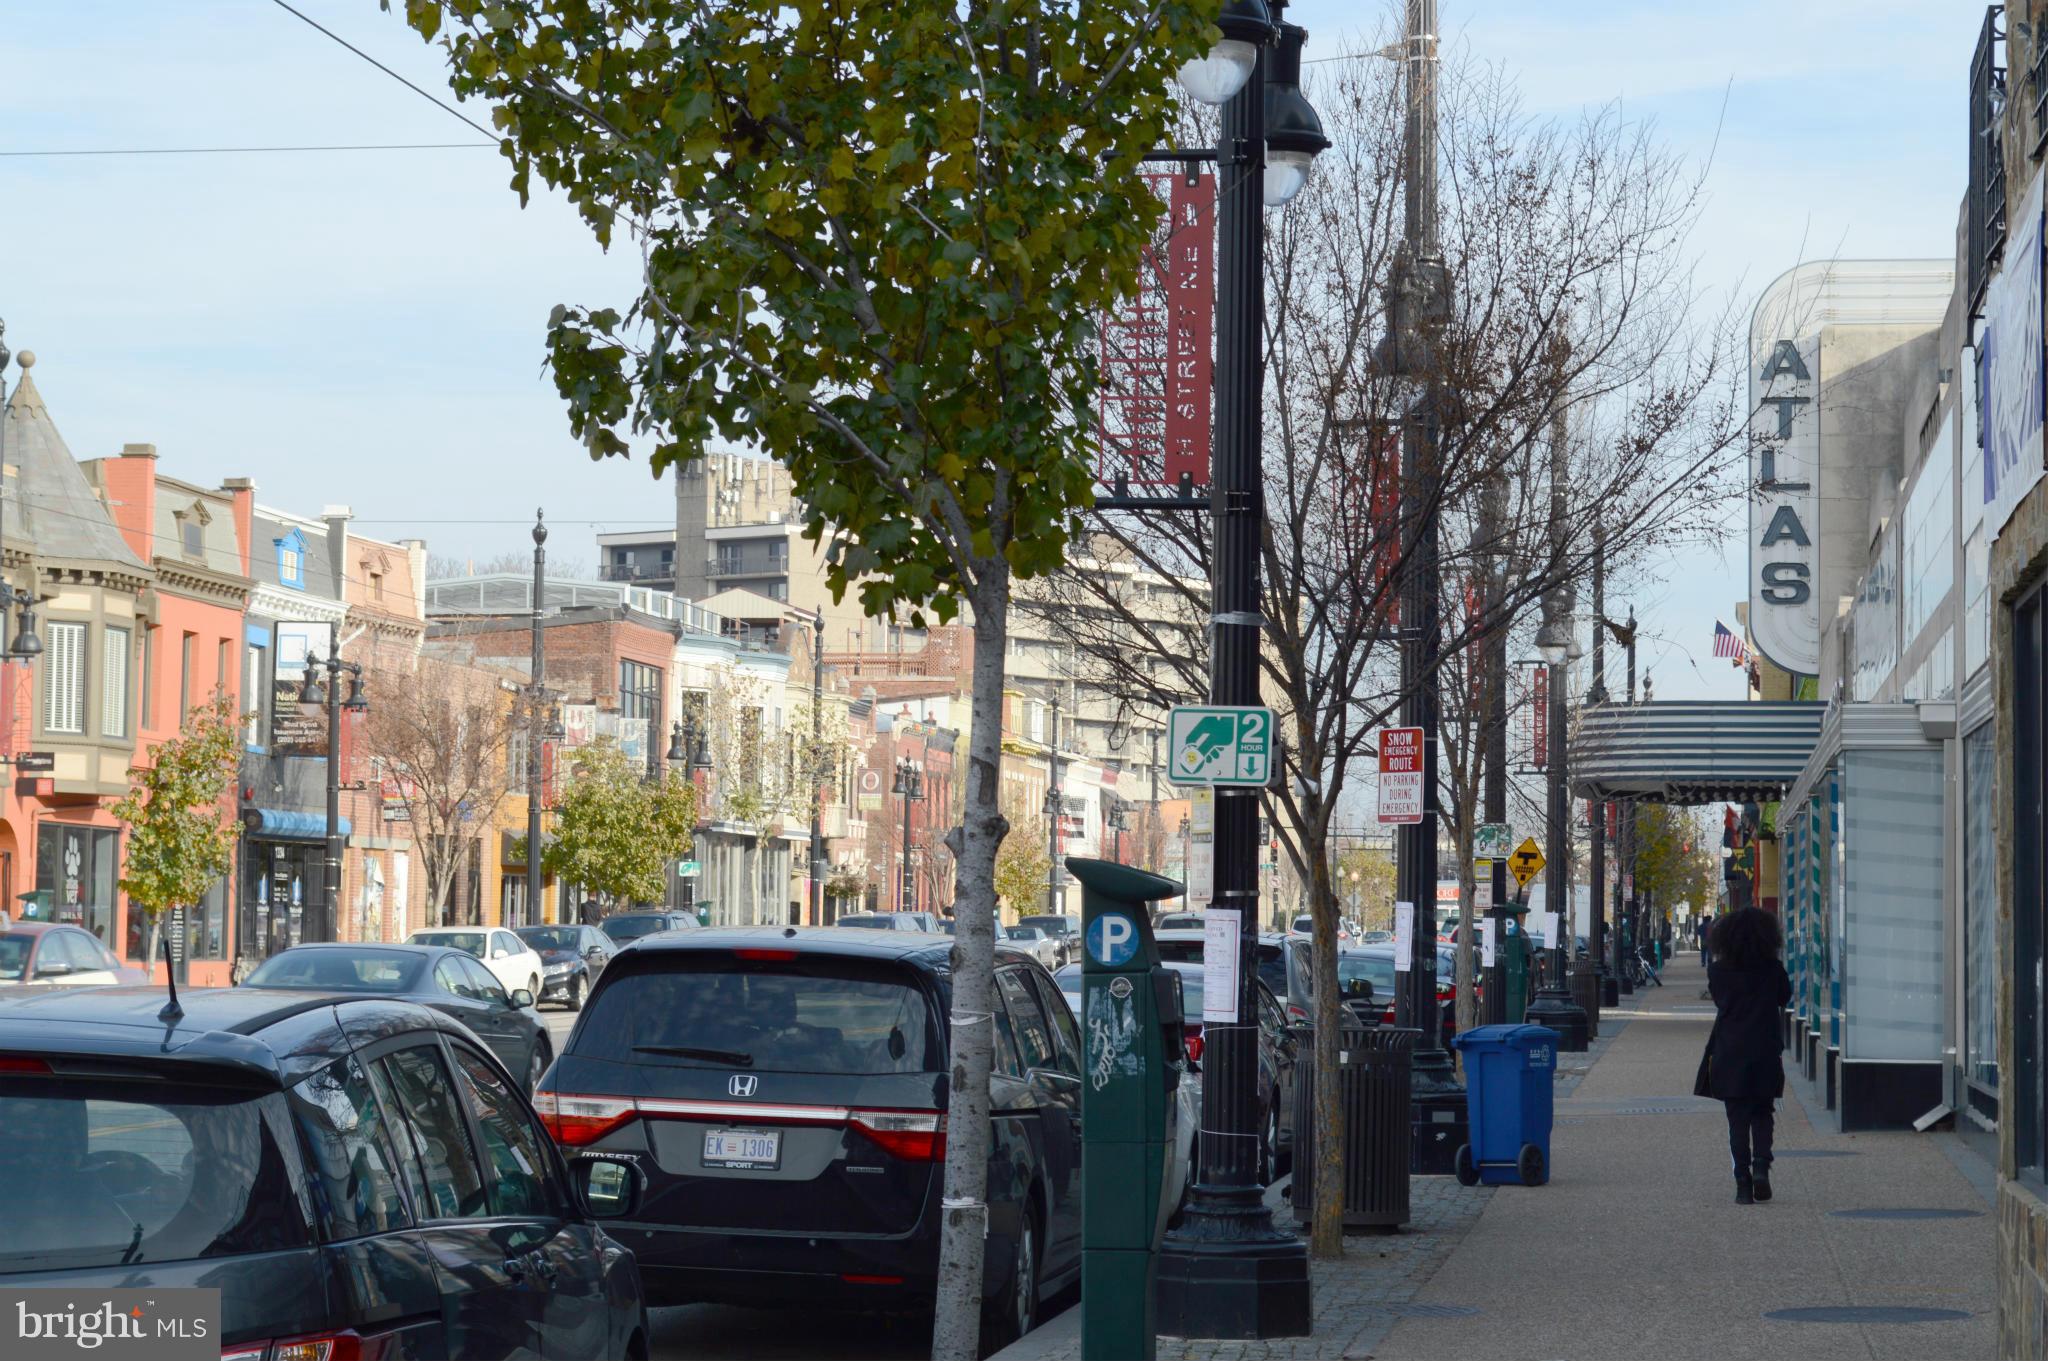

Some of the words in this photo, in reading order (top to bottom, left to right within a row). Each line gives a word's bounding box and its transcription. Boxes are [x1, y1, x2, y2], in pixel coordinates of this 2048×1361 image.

[1176, 304, 1197, 420] STREET
[1760, 339, 1811, 605] ATLAS
[1241, 713, 1264, 743] 2
[1388, 732, 1413, 746] SNOW
[1241, 744, 1263, 752] HOUR
[1384, 746, 1418, 756] EMERGENCY
[1389, 757, 1413, 770] ROUTE
[1383, 775, 1392, 786] NO
[1394, 774, 1419, 786] PARKING
[1389, 789, 1412, 800] DURING
[1382, 802, 1418, 814] EMERGENCY
[28, 902, 37, 916] P
[1506, 918, 1515, 935] P
[1103, 916, 1131, 961] P
[706, 1136, 723, 1155] EK
[741, 1138, 774, 1158] 1306
[725, 1161, 753, 1169] SPORT
